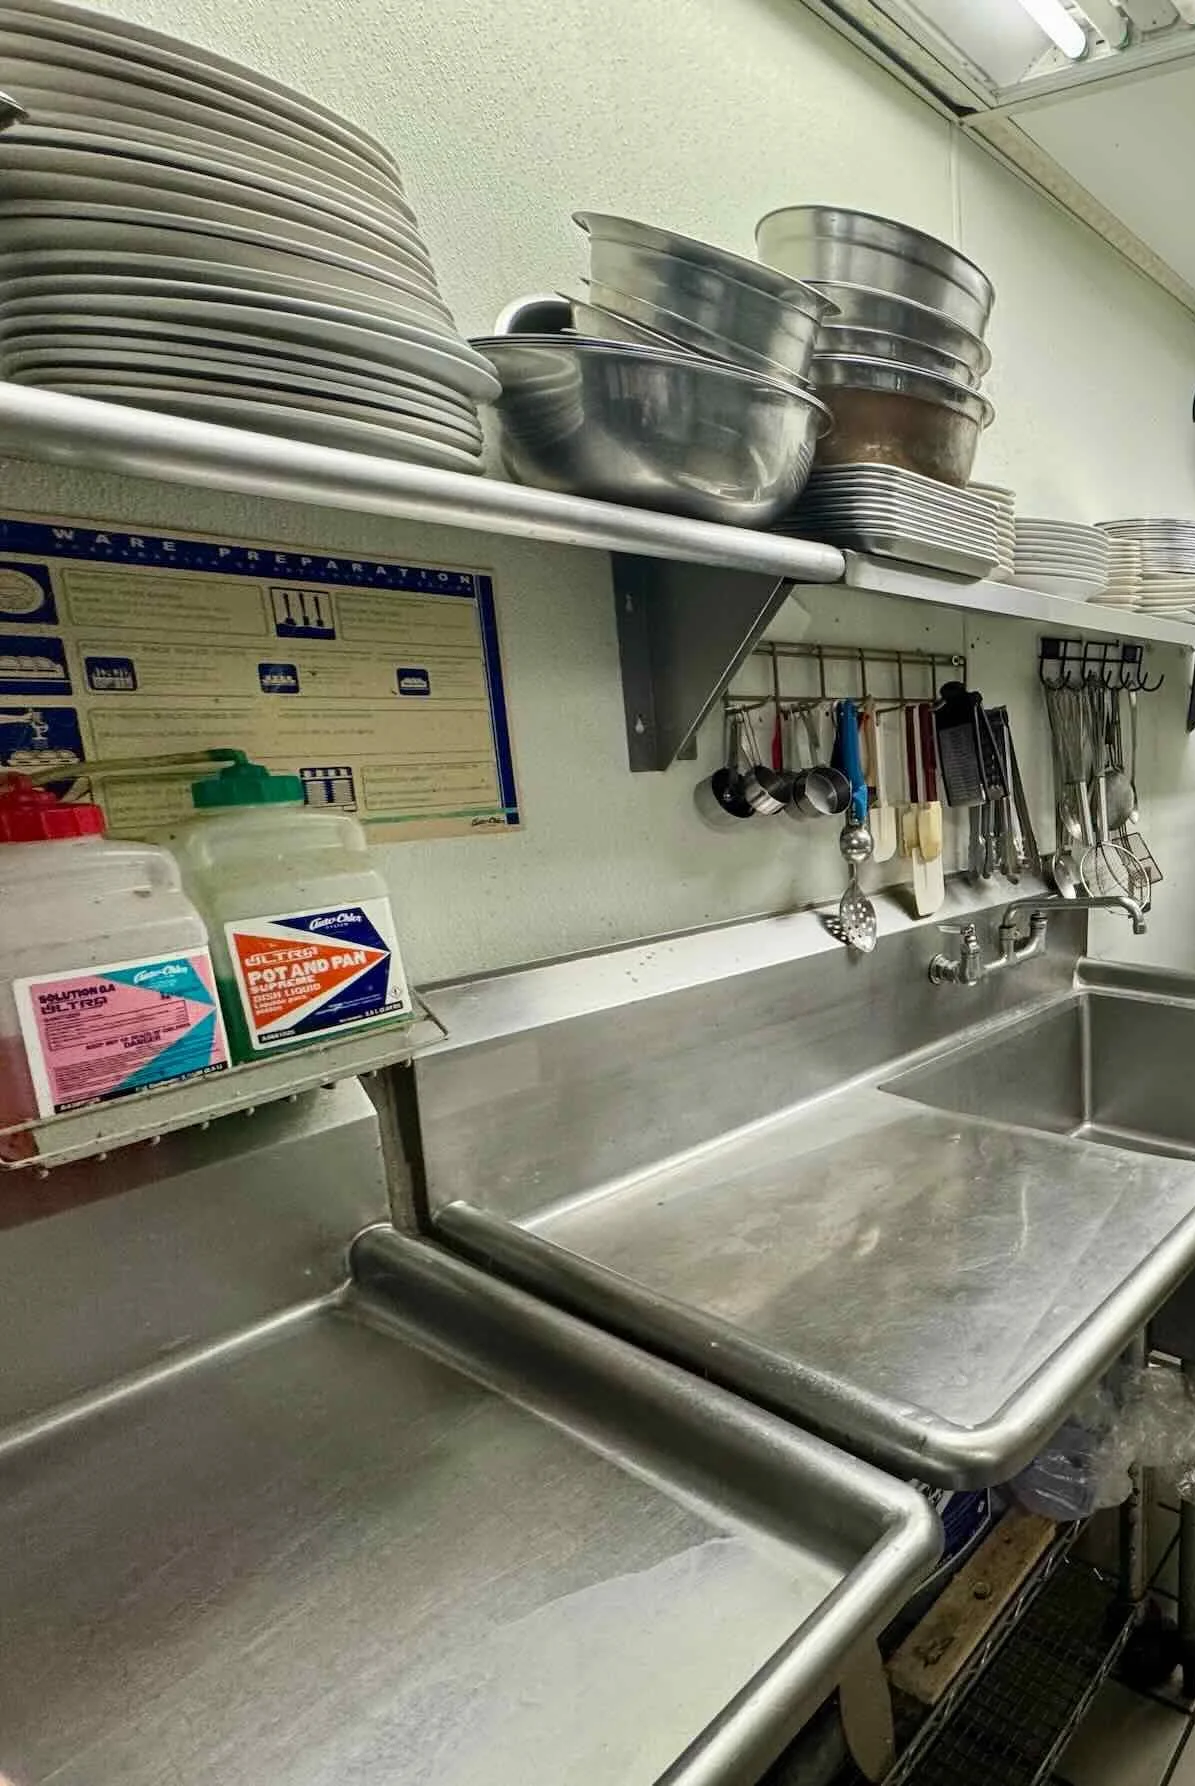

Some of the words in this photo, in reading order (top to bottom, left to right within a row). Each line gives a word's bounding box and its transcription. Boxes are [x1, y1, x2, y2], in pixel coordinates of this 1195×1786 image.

[52, 528, 177, 552] WARE
[218, 547, 473, 585] PREPARATION
[245, 946, 319, 967] ULTRA
[248, 965, 289, 987] POT
[290, 958, 330, 978] AND
[331, 951, 368, 971] PAN
[38, 986, 98, 1004] SOLUTION
[250, 974, 315, 995] SUPREME
[284, 982, 321, 997] LIQUID
[41, 996, 108, 1015] ULTRA
